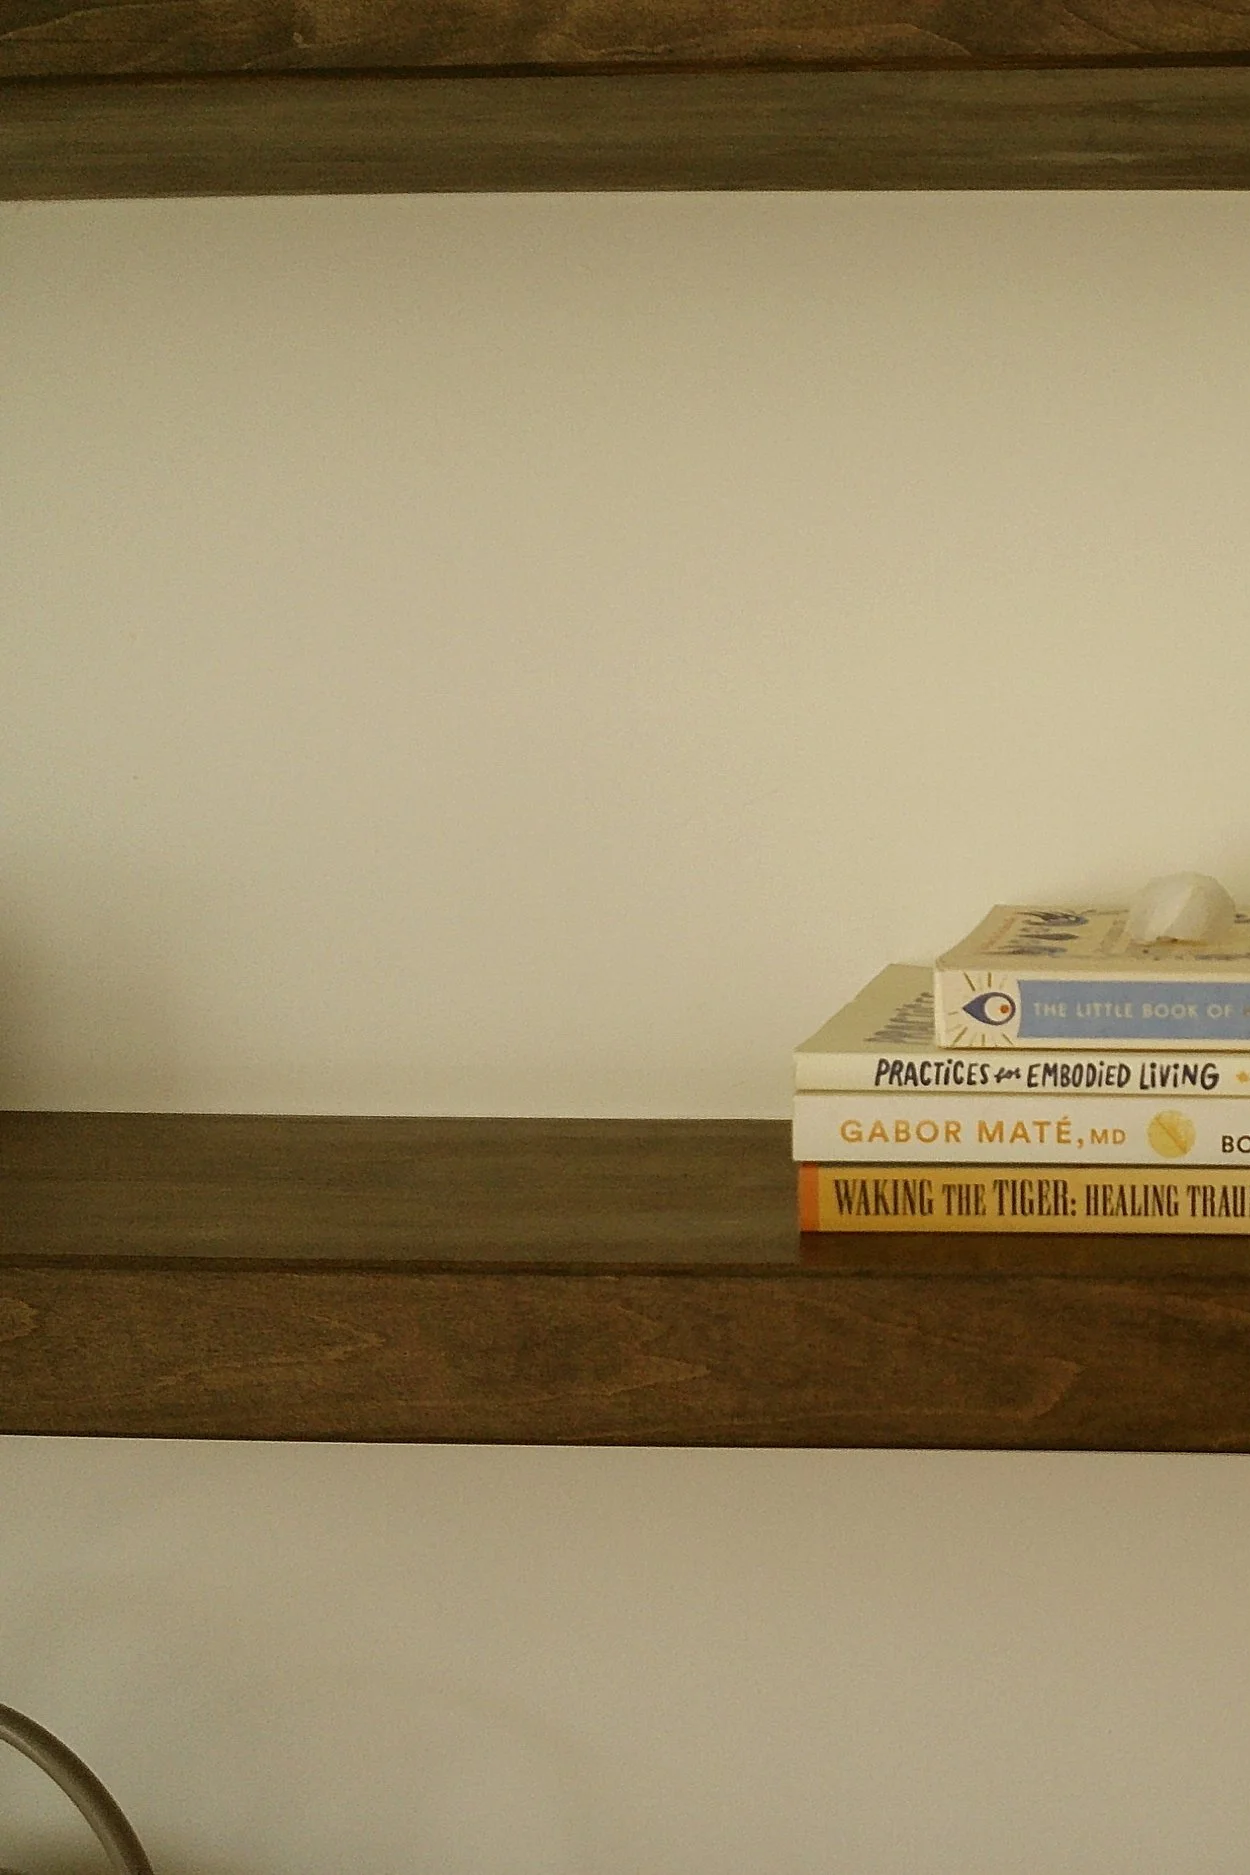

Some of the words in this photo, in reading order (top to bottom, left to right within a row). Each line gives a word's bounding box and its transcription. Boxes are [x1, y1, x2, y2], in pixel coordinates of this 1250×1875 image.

[1033, 1002, 1066, 1018] THE
[1076, 1002, 1133, 1019] LITTLE
[1141, 1003, 1198, 1019] BOOK
[1206, 1003, 1234, 1019] OF
[994, 1066, 1021, 1083] for
[839, 1118, 962, 1144] GABOR
[977, 1116, 1085, 1149] MATÉ,
[1090, 1128, 1127, 1145] MD
[833, 1178, 934, 1217] WAKING
[942, 1182, 987, 1217] THE
[993, 1178, 1077, 1218] TIGER:
[1086, 1183, 1179, 1218] HEALING
